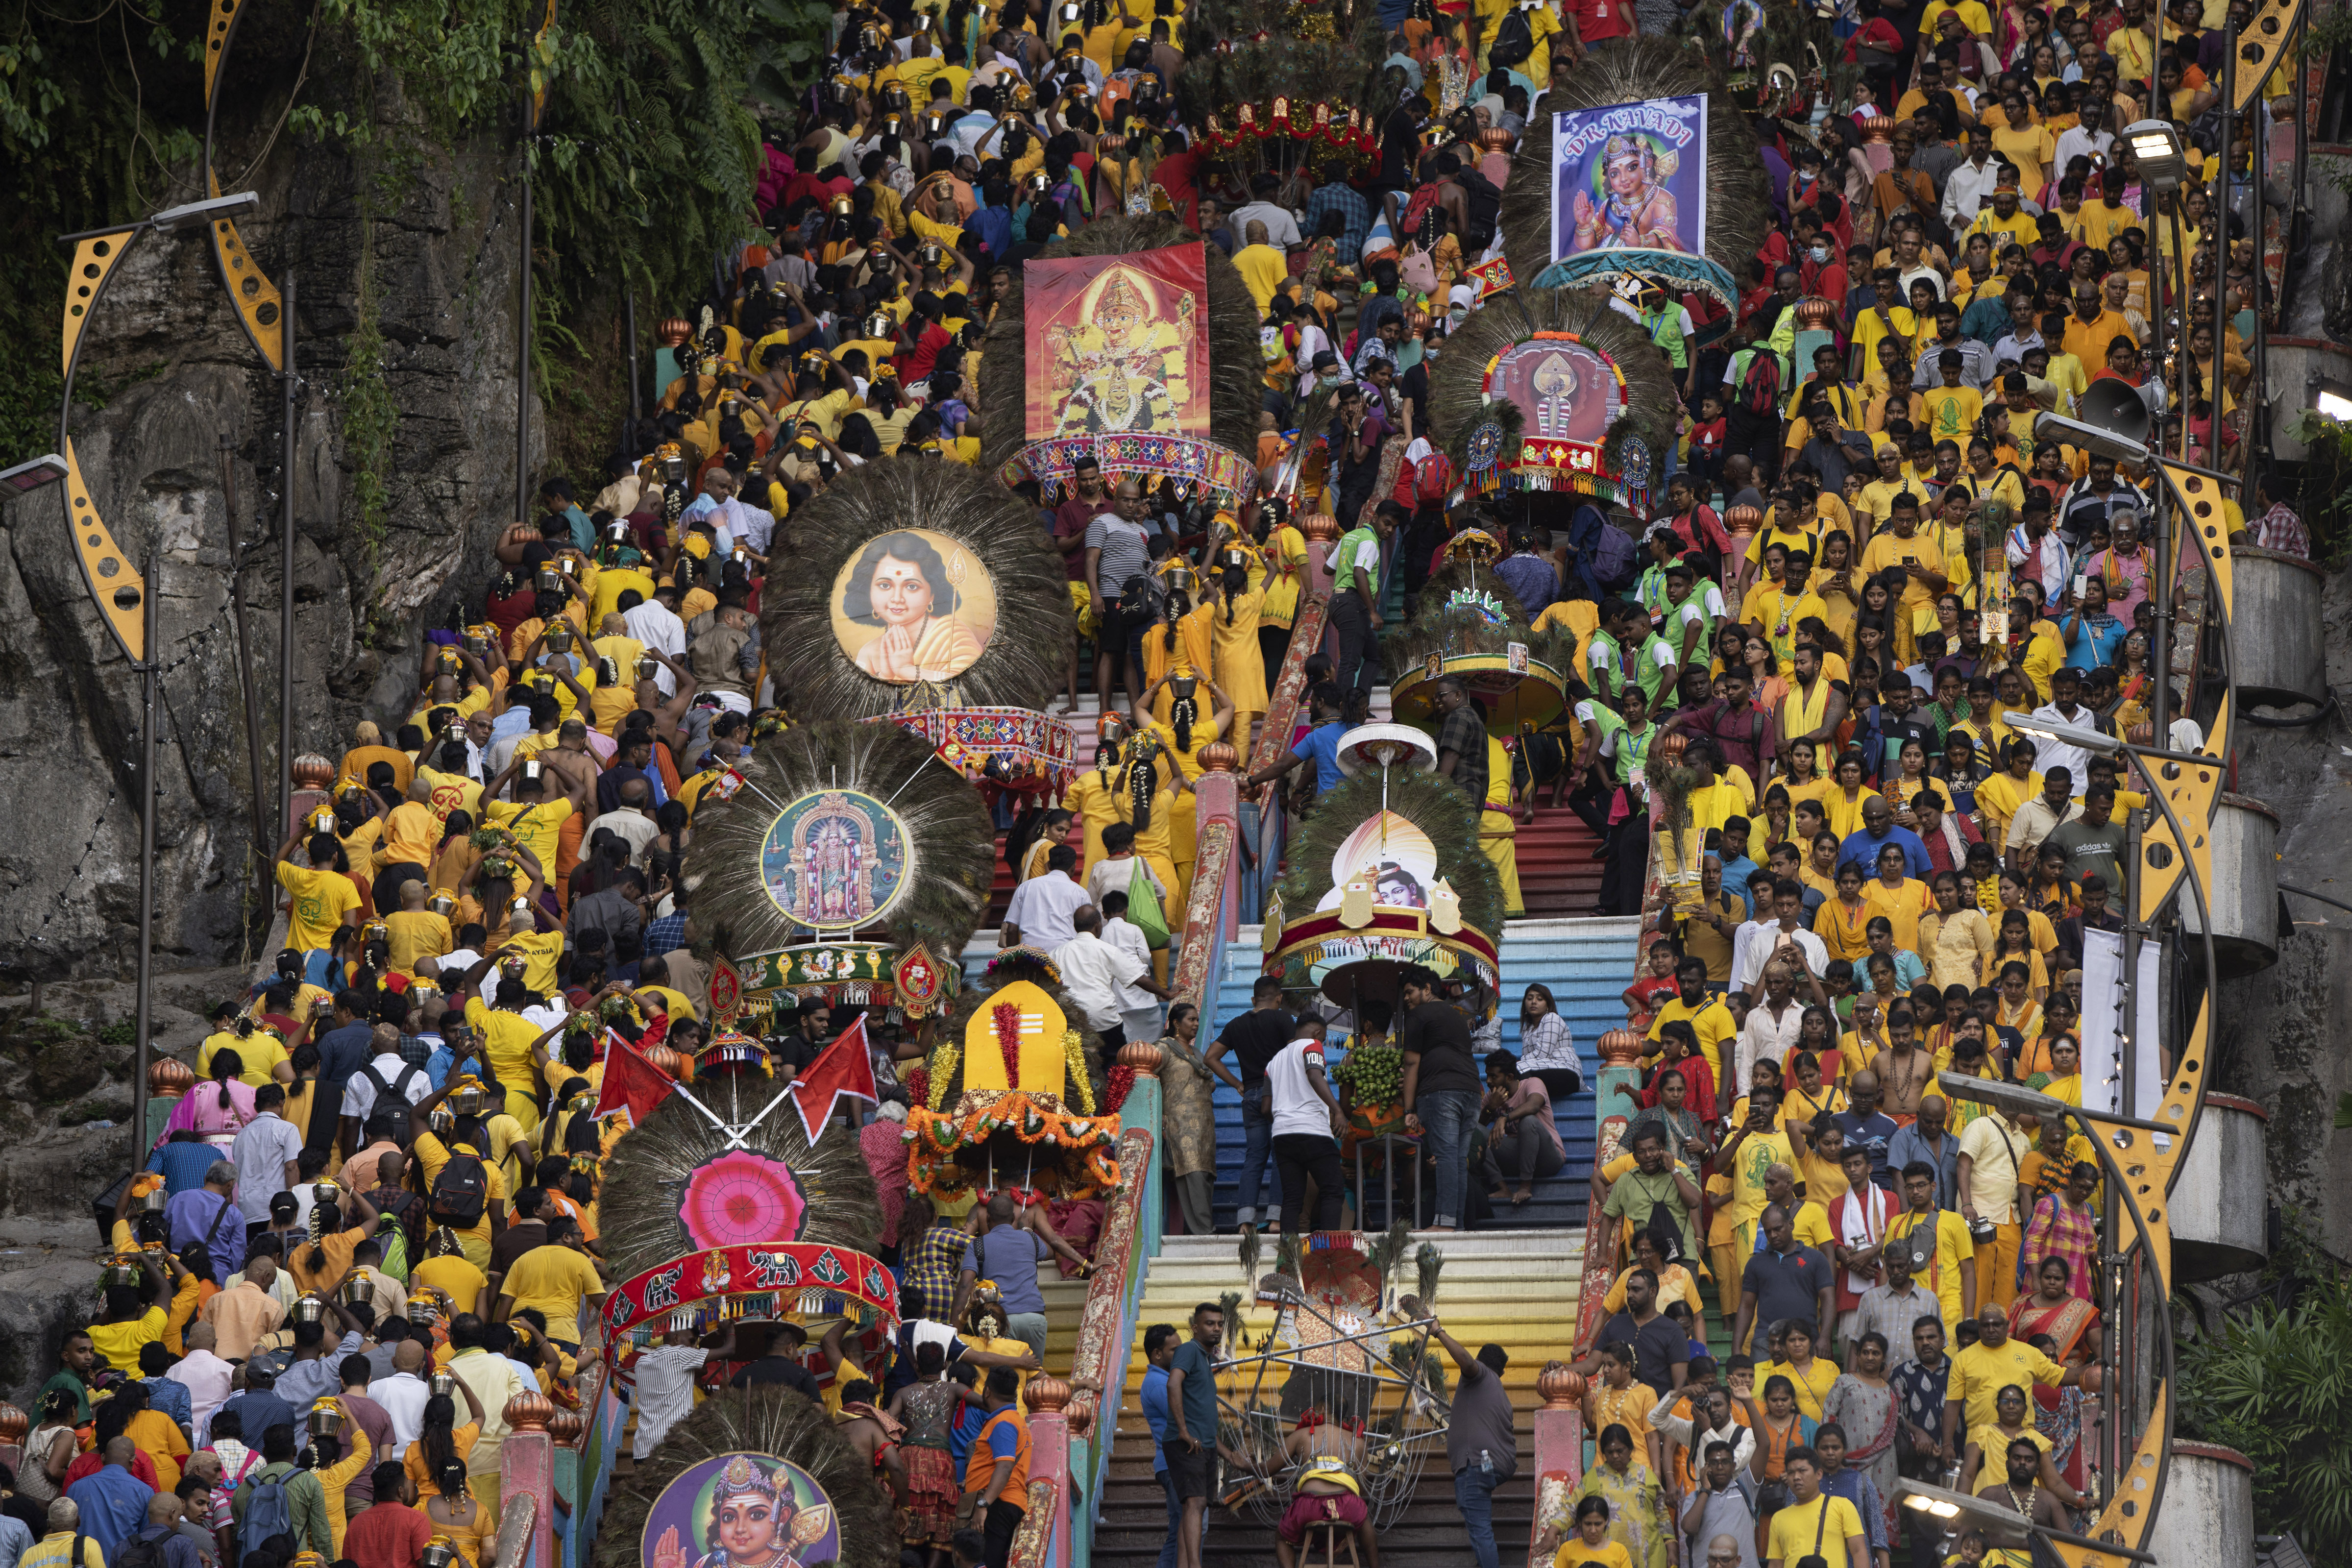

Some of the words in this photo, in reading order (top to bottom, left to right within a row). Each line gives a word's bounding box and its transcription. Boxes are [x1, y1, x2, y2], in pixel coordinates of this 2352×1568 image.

[1567, 123, 1605, 154] DR.
[1603, 109, 1691, 146] KAVADI
[2076, 843, 2102, 853] adidas
[1306, 1052, 1324, 1067] YOUR
